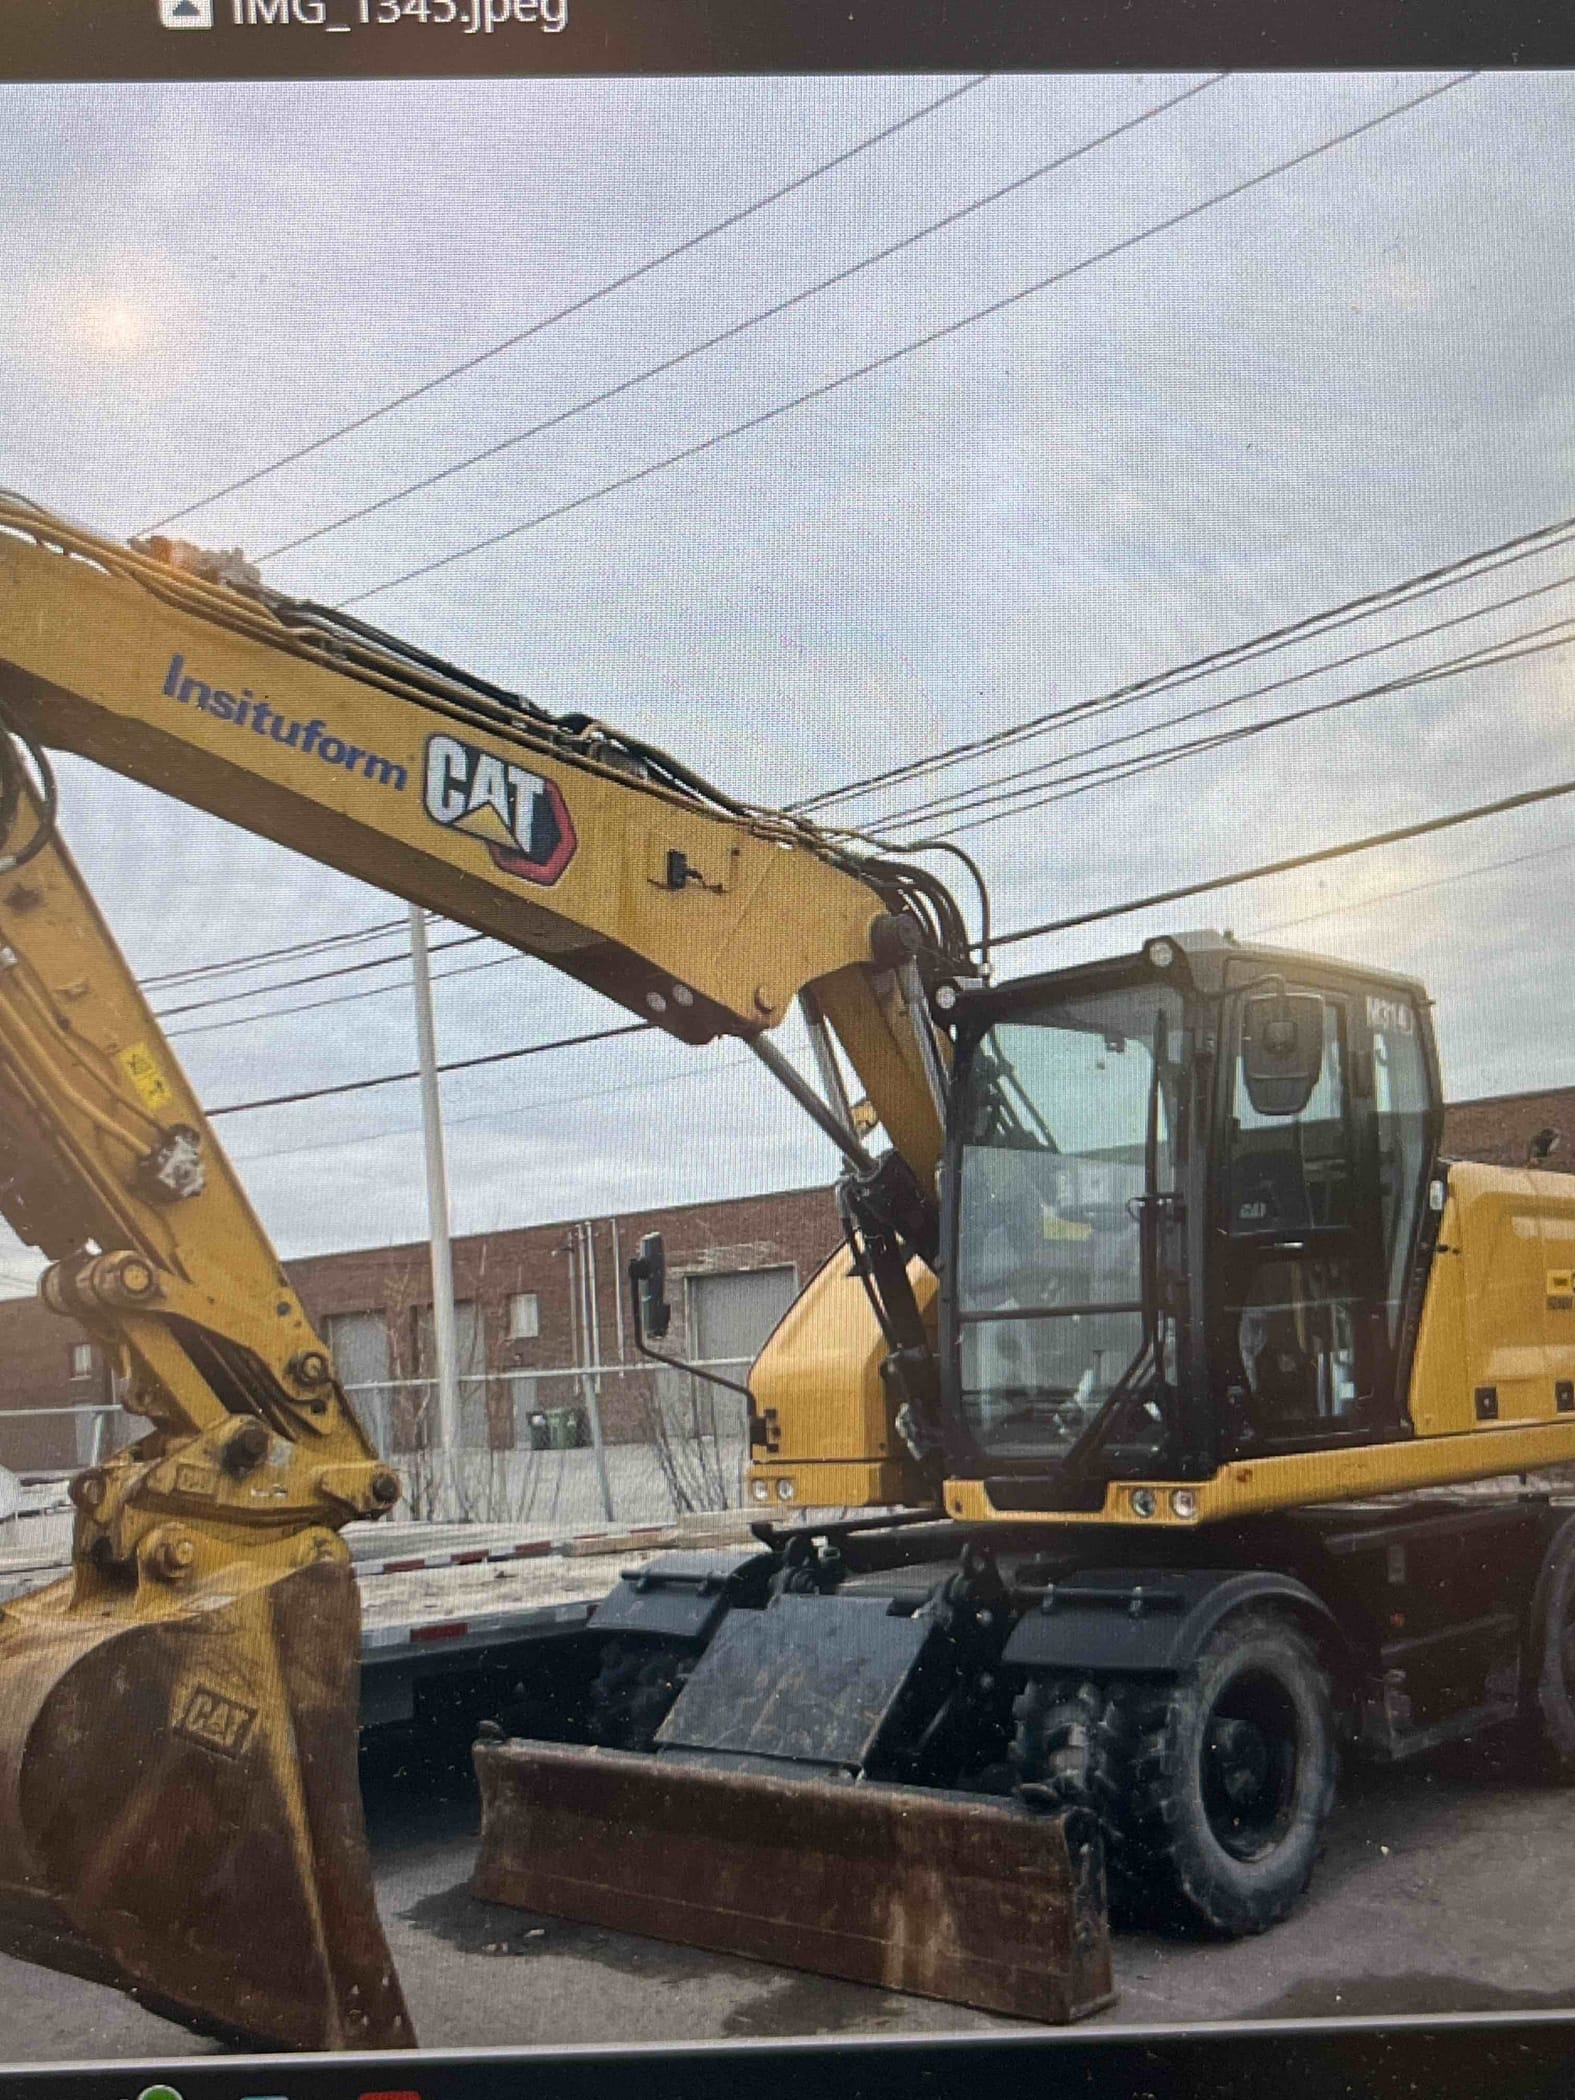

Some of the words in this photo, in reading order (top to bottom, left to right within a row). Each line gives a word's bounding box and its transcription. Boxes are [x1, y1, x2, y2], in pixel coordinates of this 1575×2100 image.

[163, 653, 408, 792] Insituform
[425, 734, 548, 854] CAT
[185, 1694, 249, 1747] CAT
